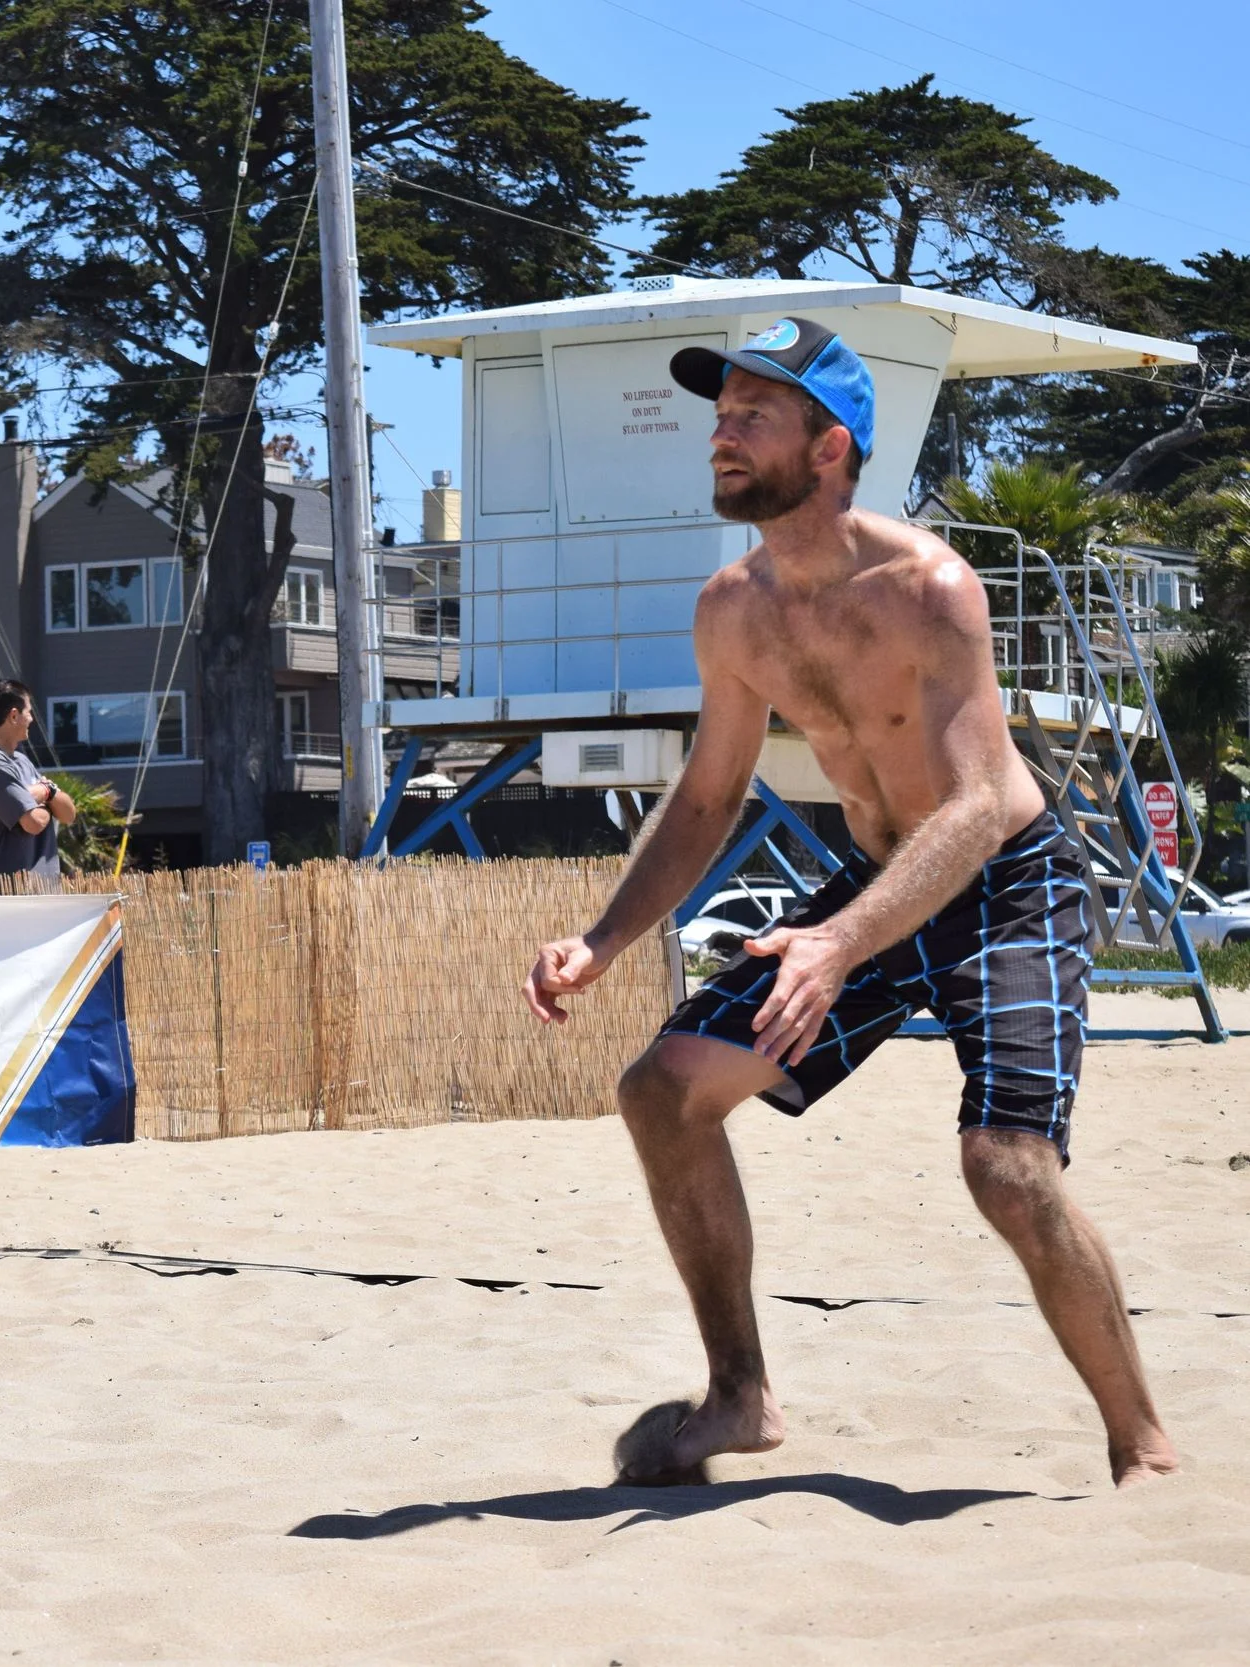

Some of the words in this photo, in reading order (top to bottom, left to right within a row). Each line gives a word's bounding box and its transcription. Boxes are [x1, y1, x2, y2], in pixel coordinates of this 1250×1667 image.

[622, 391, 633, 401] NO
[633, 389, 673, 401] LIFEGUARD
[632, 407, 642, 417] ON
[643, 406, 662, 417] DUTY
[622, 424, 639, 435] STAY
[640, 423, 653, 434] OFF
[654, 422, 680, 433] TOWER
[1148, 791, 1158, 801] DO
[1159, 791, 1171, 801] NOT
[1151, 811, 1170, 821] ENTER
[1154, 836, 1175, 848] RONG
[1159, 851, 1170, 862] AY
